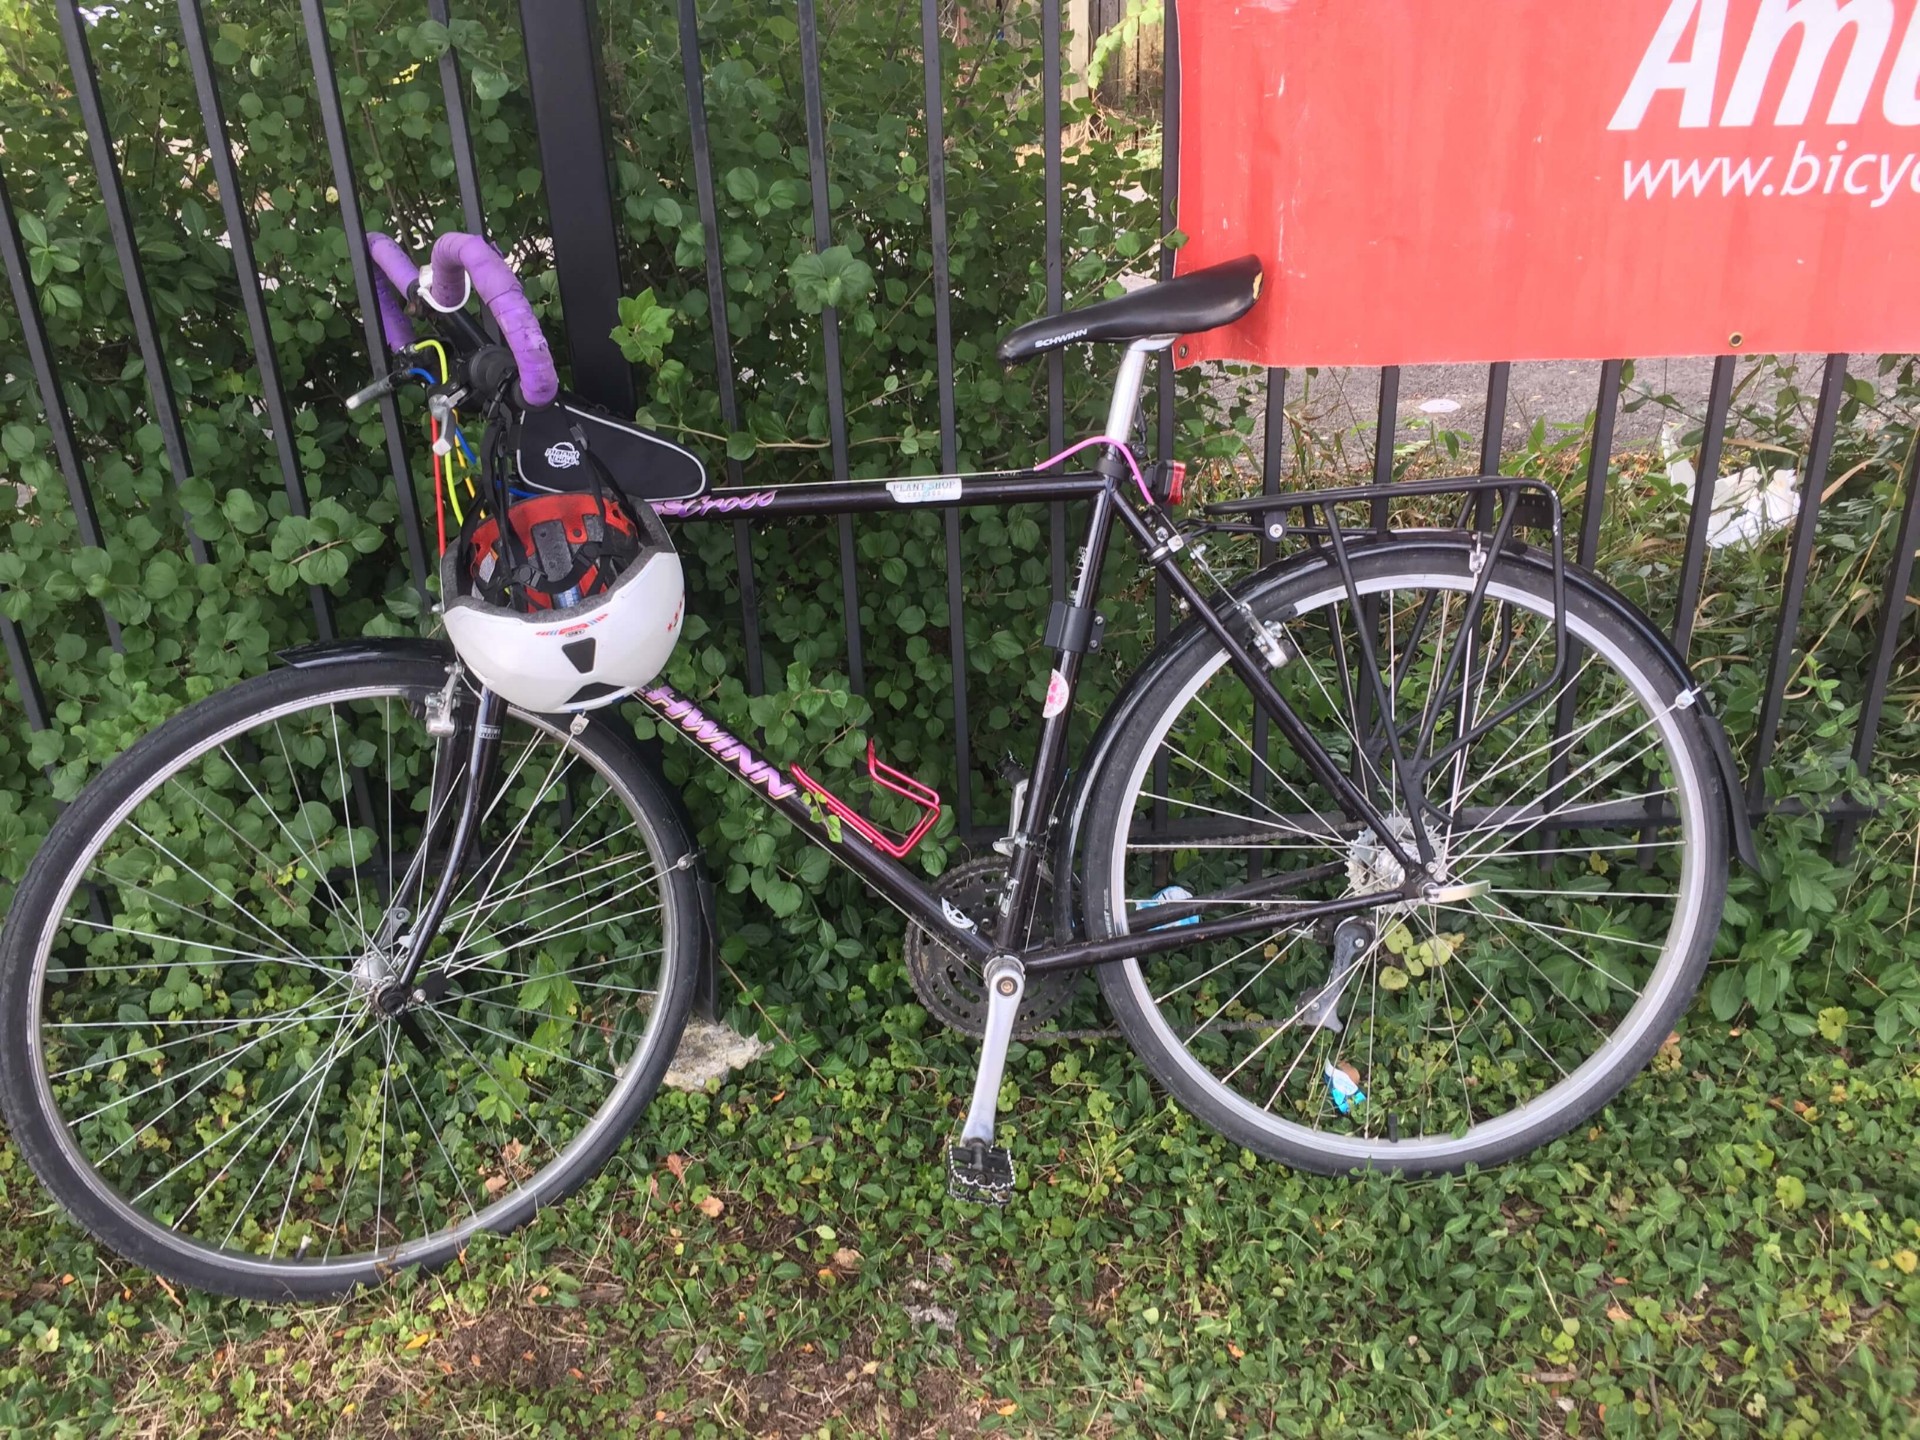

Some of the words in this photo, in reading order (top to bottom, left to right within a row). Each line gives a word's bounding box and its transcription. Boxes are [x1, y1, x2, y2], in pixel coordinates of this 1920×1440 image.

[1034, 328, 1088, 349] SCHWINN
[893, 482, 925, 492] PLANT
[928, 480, 956, 490] SHOP
